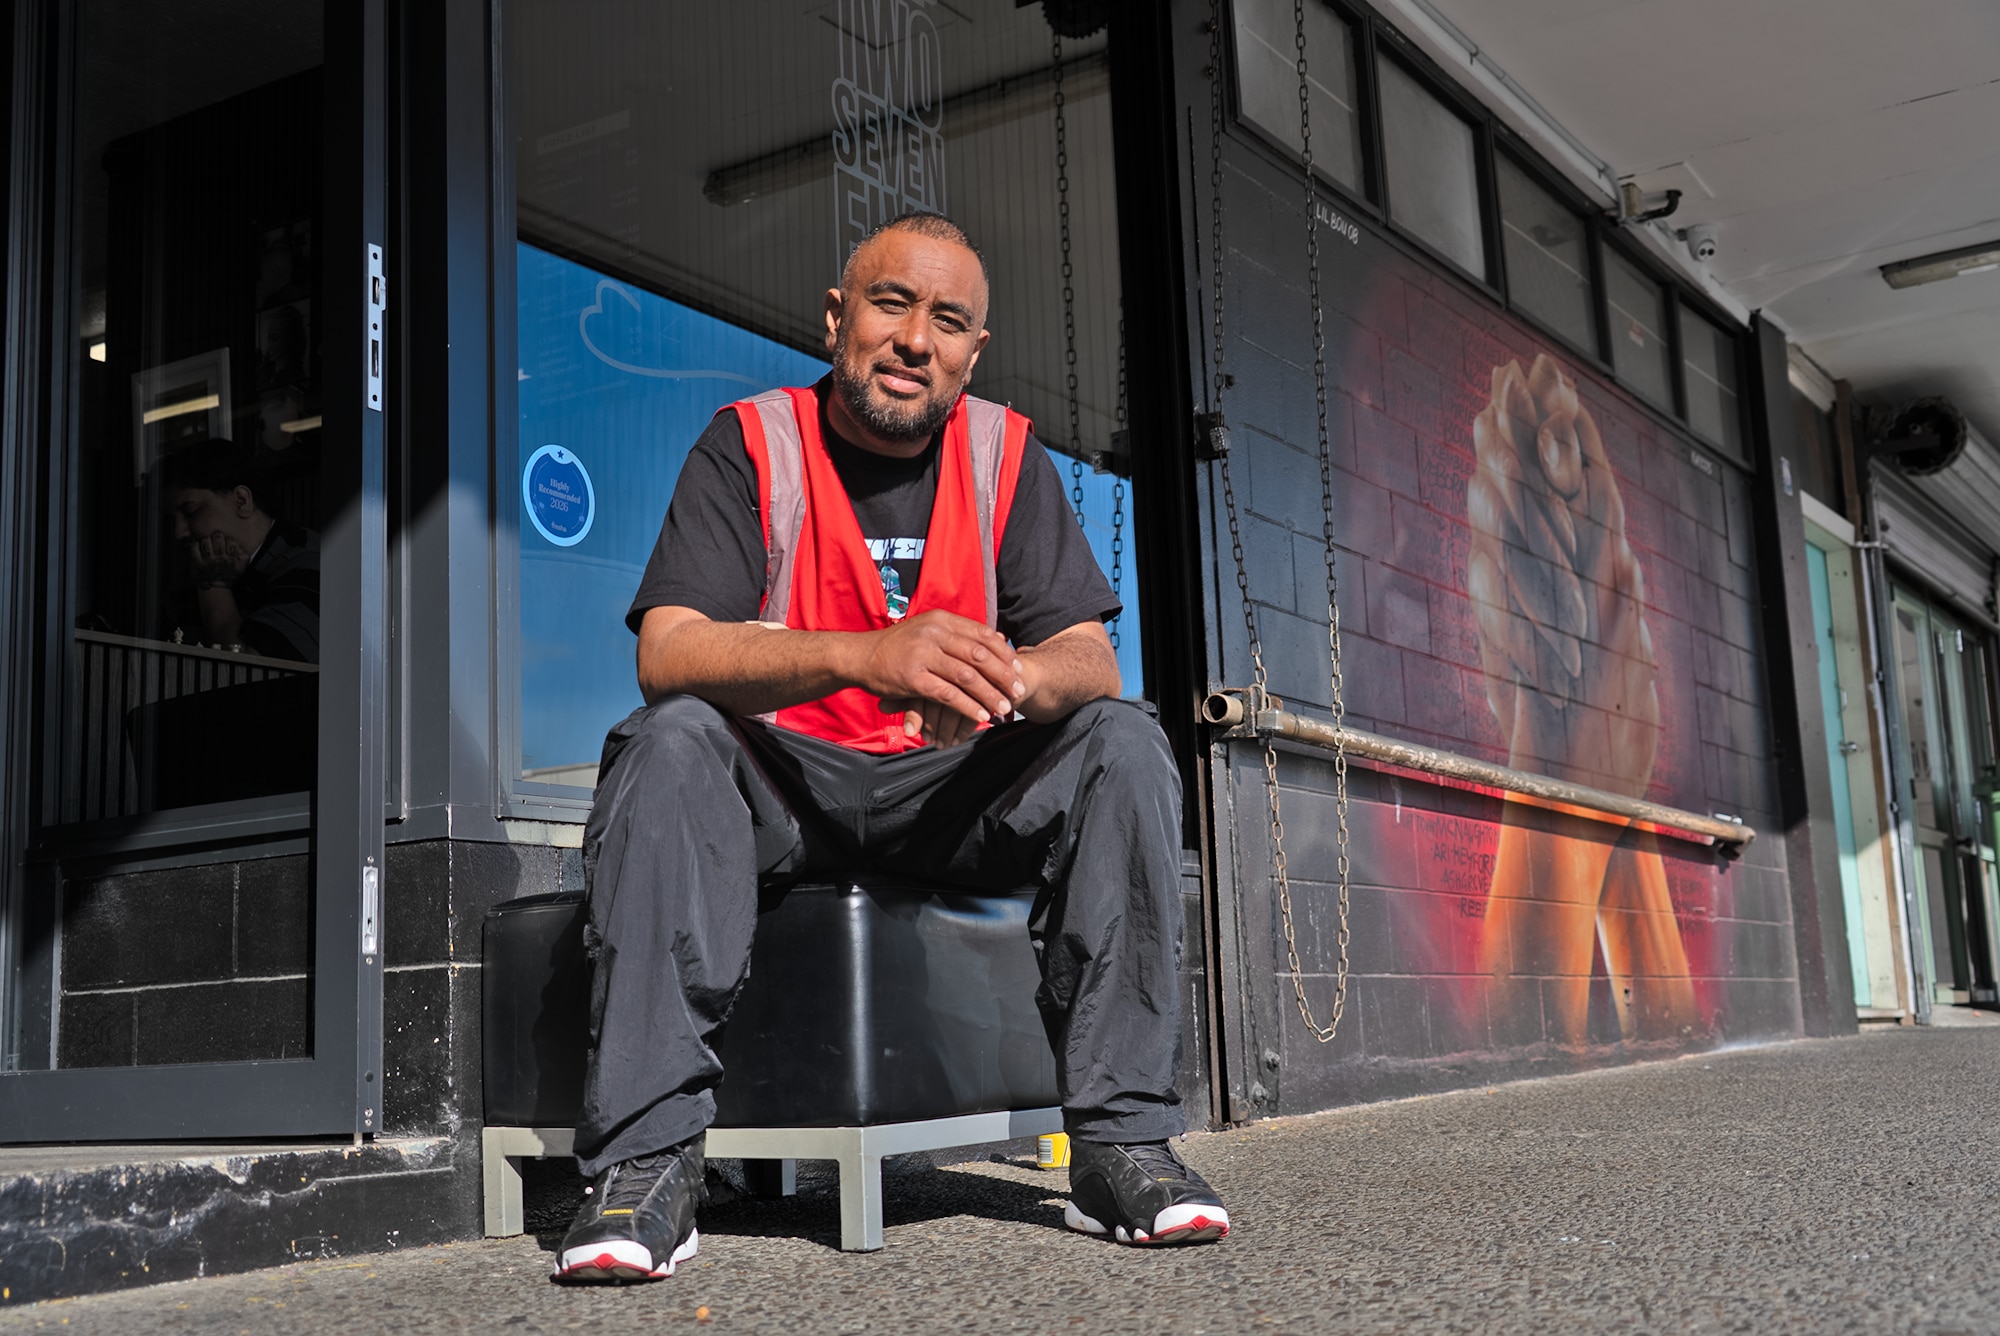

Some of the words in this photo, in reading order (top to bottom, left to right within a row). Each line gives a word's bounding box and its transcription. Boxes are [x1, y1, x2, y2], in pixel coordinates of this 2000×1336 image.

[831, 77, 947, 213] SEVEN
[1316, 202, 1329, 224] LIL
[538, 483, 581, 504] Recommended
[550, 478, 570, 493] Highly
[550, 497, 569, 512] 2026
